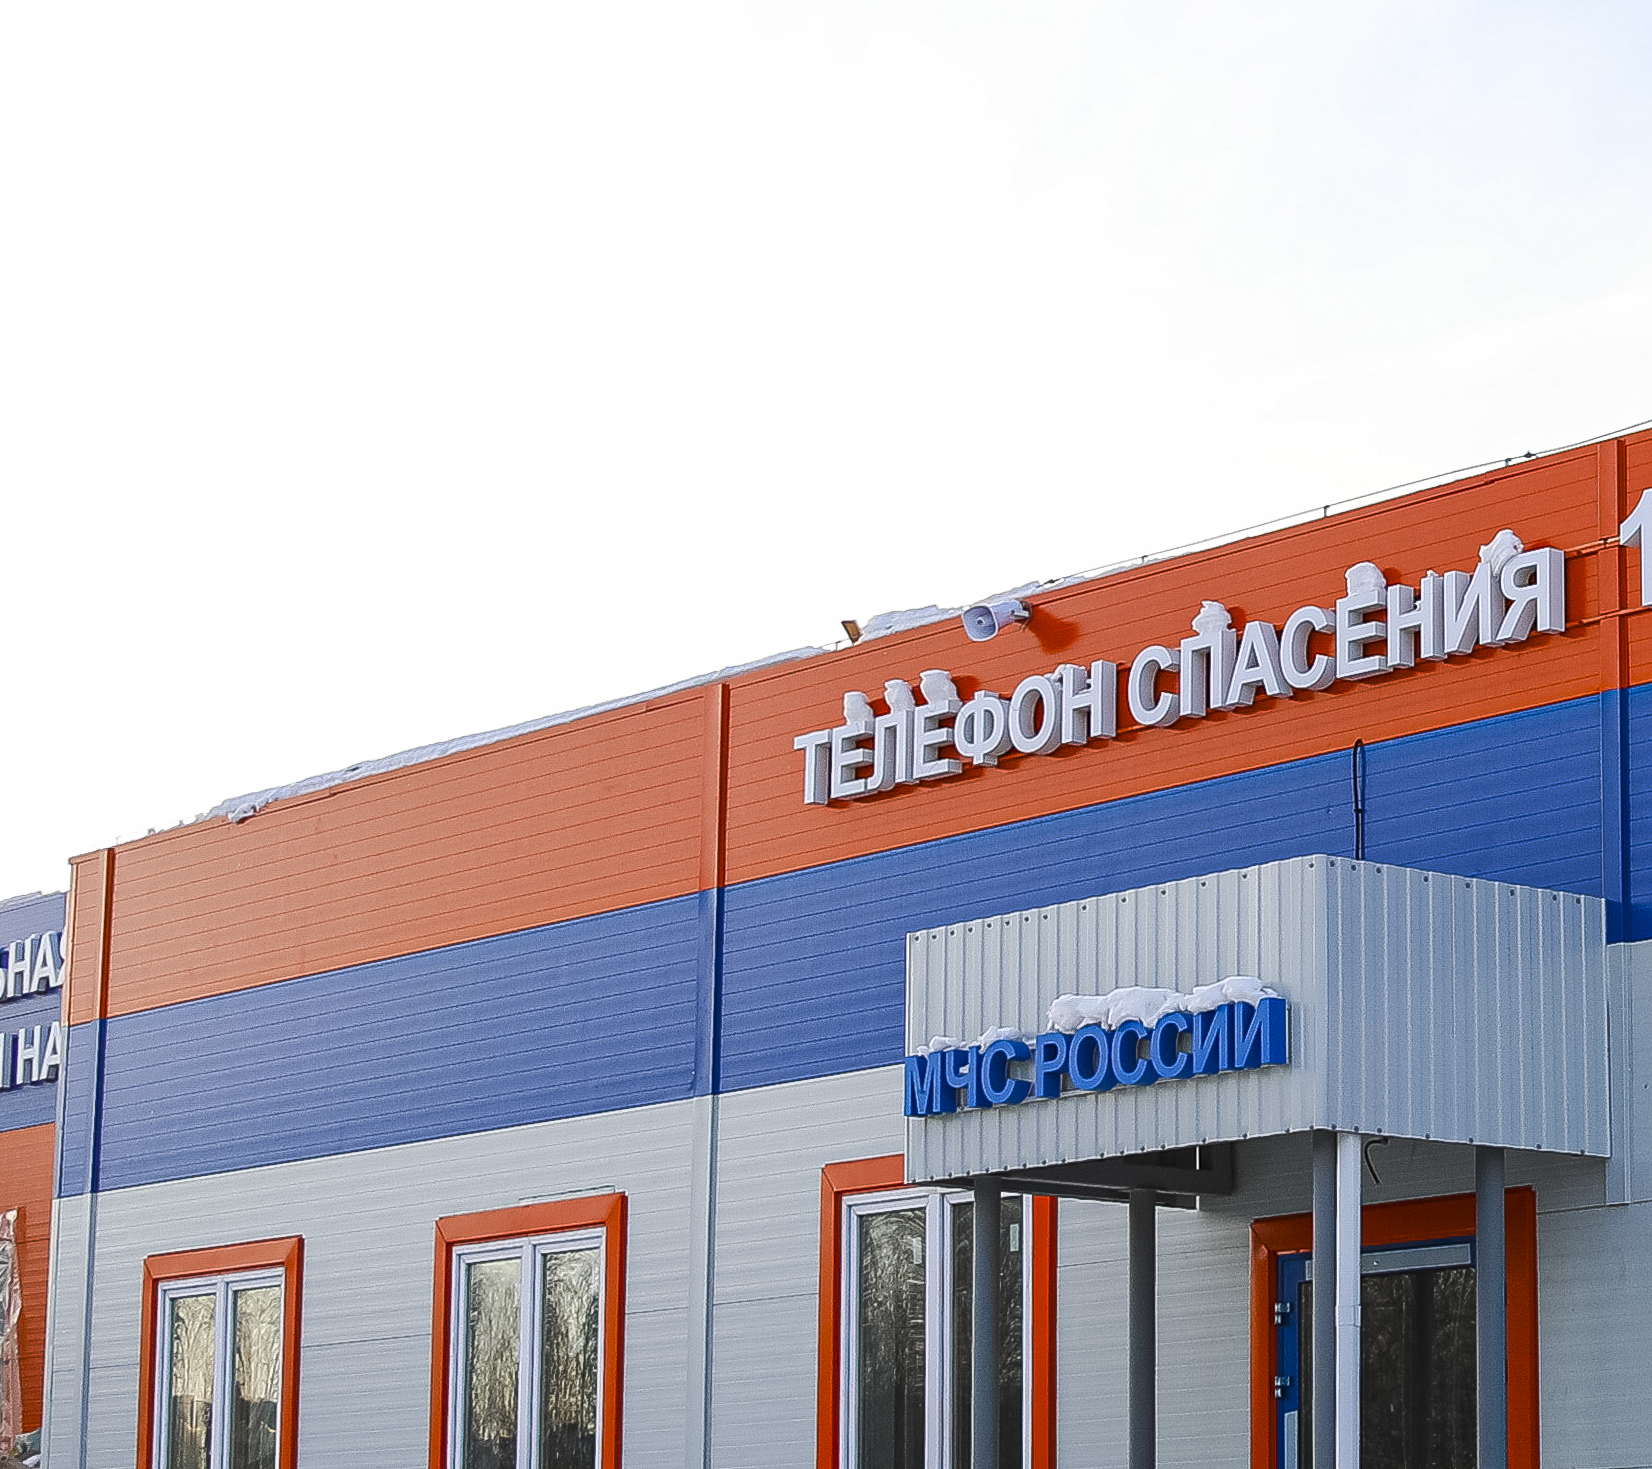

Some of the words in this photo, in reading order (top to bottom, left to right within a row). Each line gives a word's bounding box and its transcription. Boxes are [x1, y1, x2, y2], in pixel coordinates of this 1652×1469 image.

[794, 659, 1117, 804] ТЕЛЕФОН
[1128, 546, 1566, 726] СПАСЕНИЯ
[16, 1021, 61, 1085] НА
[905, 1039, 1033, 1117] МЧС
[1035, 997, 1287, 1099] РОССИИ
